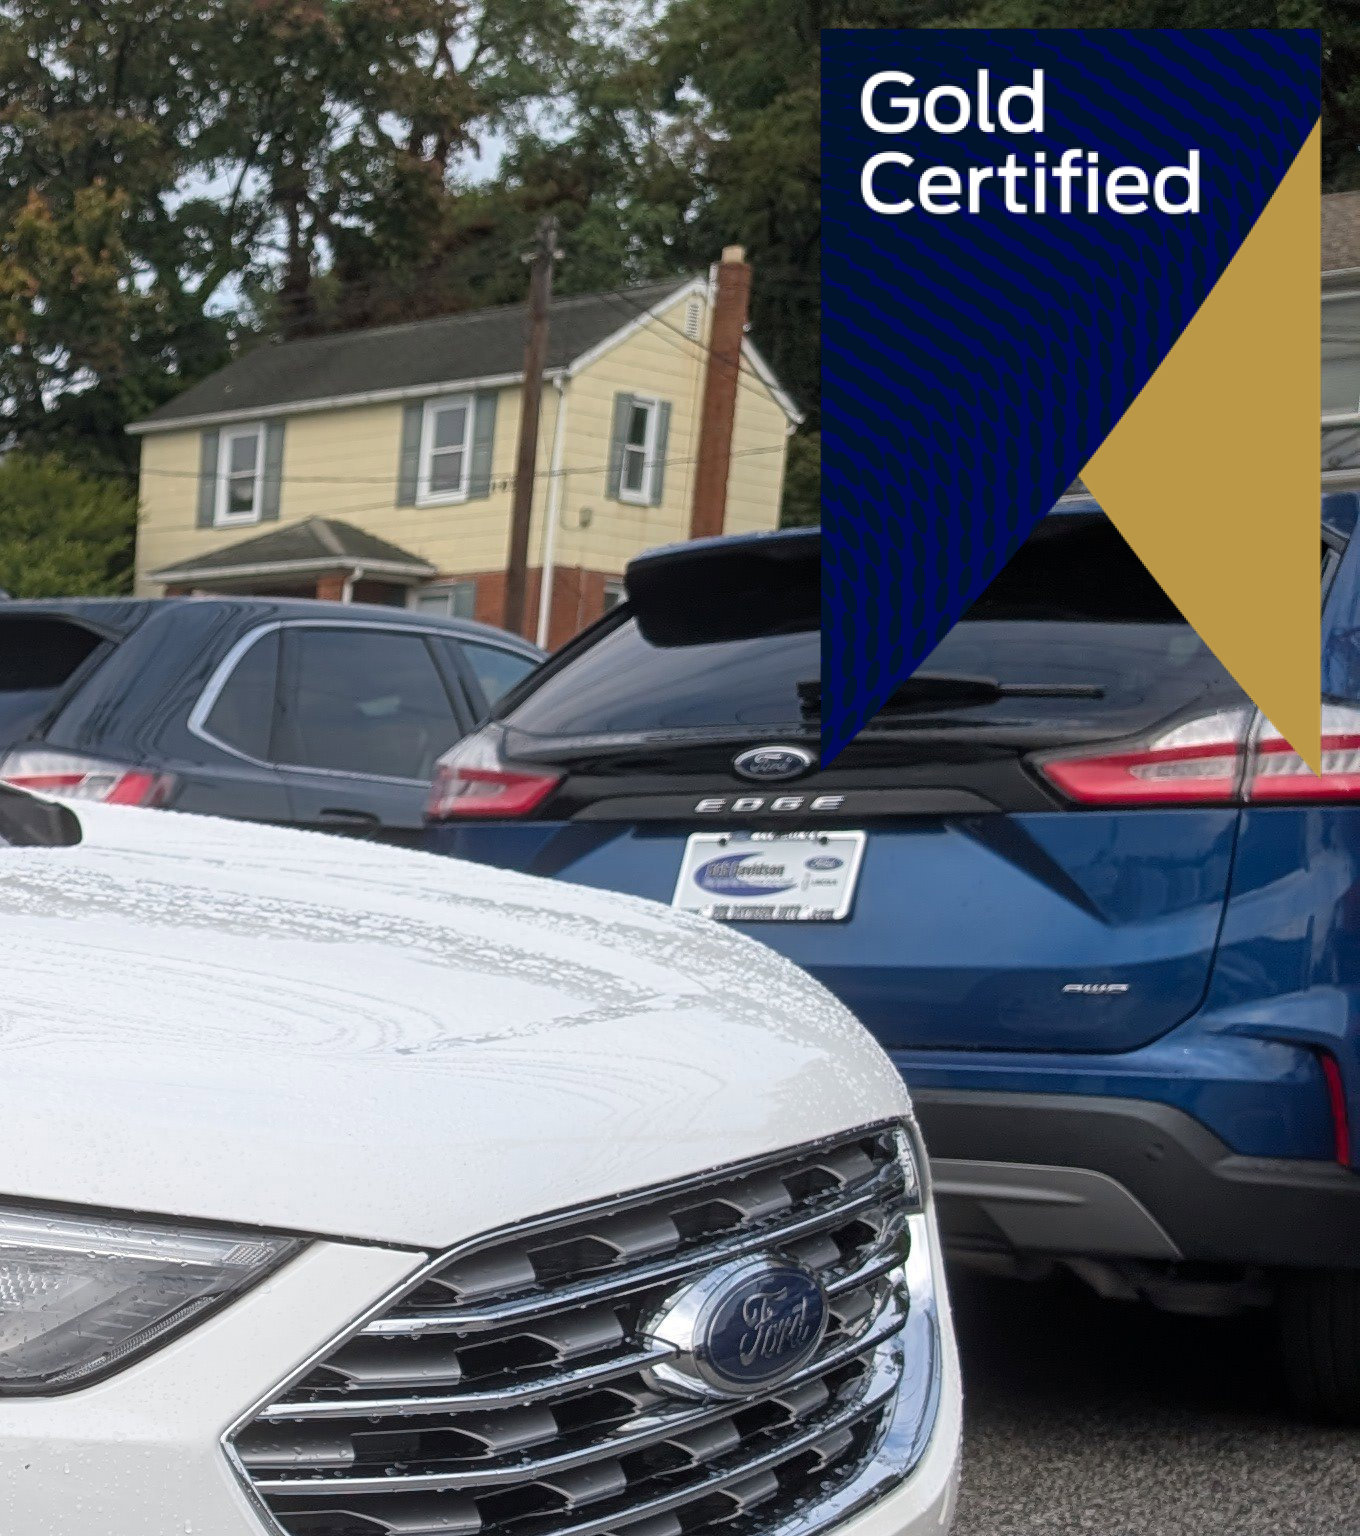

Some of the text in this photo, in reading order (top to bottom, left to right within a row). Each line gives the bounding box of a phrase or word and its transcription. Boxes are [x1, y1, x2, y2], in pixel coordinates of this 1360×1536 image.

[749, 753, 793, 774] Ford
[694, 795, 846, 813] EDGE
[739, 1286, 810, 1366] Ford
